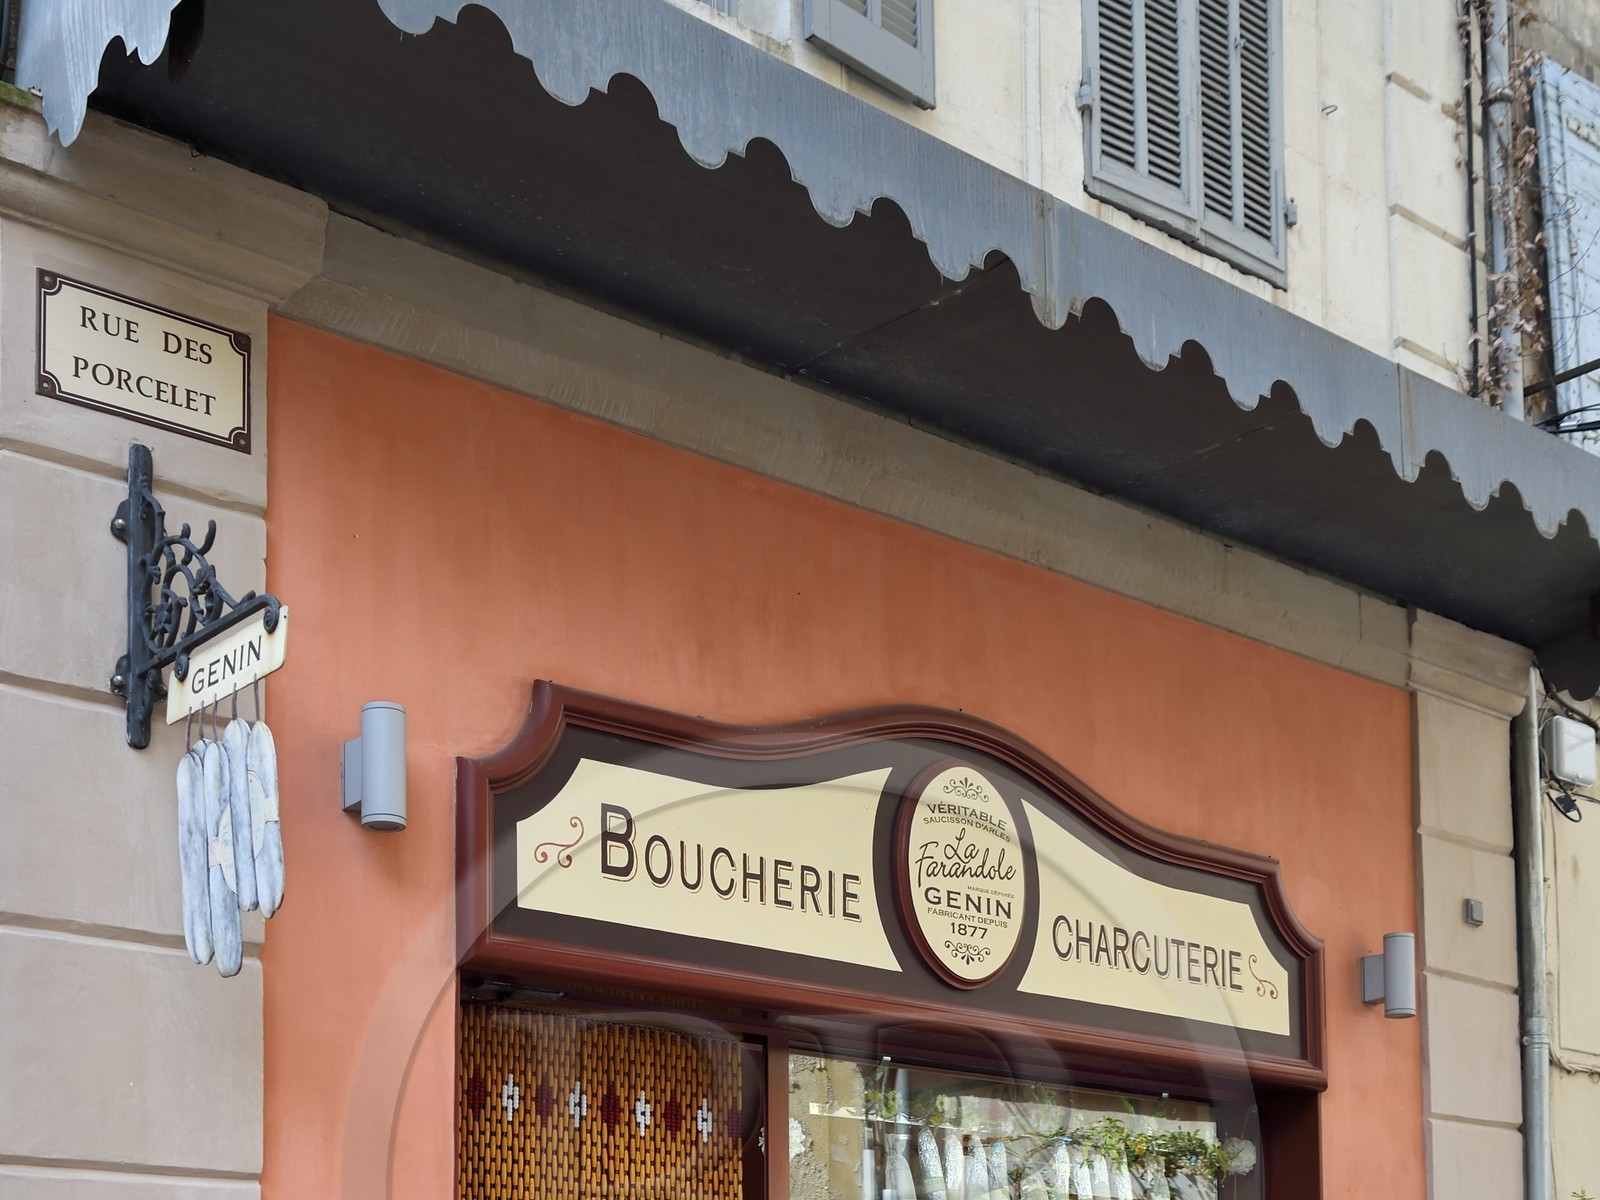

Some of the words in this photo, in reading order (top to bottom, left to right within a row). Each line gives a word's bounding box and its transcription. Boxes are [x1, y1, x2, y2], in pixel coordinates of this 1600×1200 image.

[79, 305, 140, 344] RUE
[162, 332, 214, 365] DES
[71, 355, 216, 416] PORCELET
[191, 634, 264, 695] GENIN
[923, 816, 974, 827] SAUCISSON
[975, 821, 1011, 843] D'ARLES
[927, 801, 1008, 831] VÉRITABLE
[600, 802, 863, 924] BOUCHERIE
[915, 840, 1017, 888] Farandole
[943, 827, 980, 864] La
[924, 886, 1012, 919] GENIN
[927, 907, 976, 923] FABRICANT
[977, 916, 1008, 928] DEPUIS
[950, 922, 988, 939] 1877
[1052, 914, 1244, 992] CHARCUTERIE
